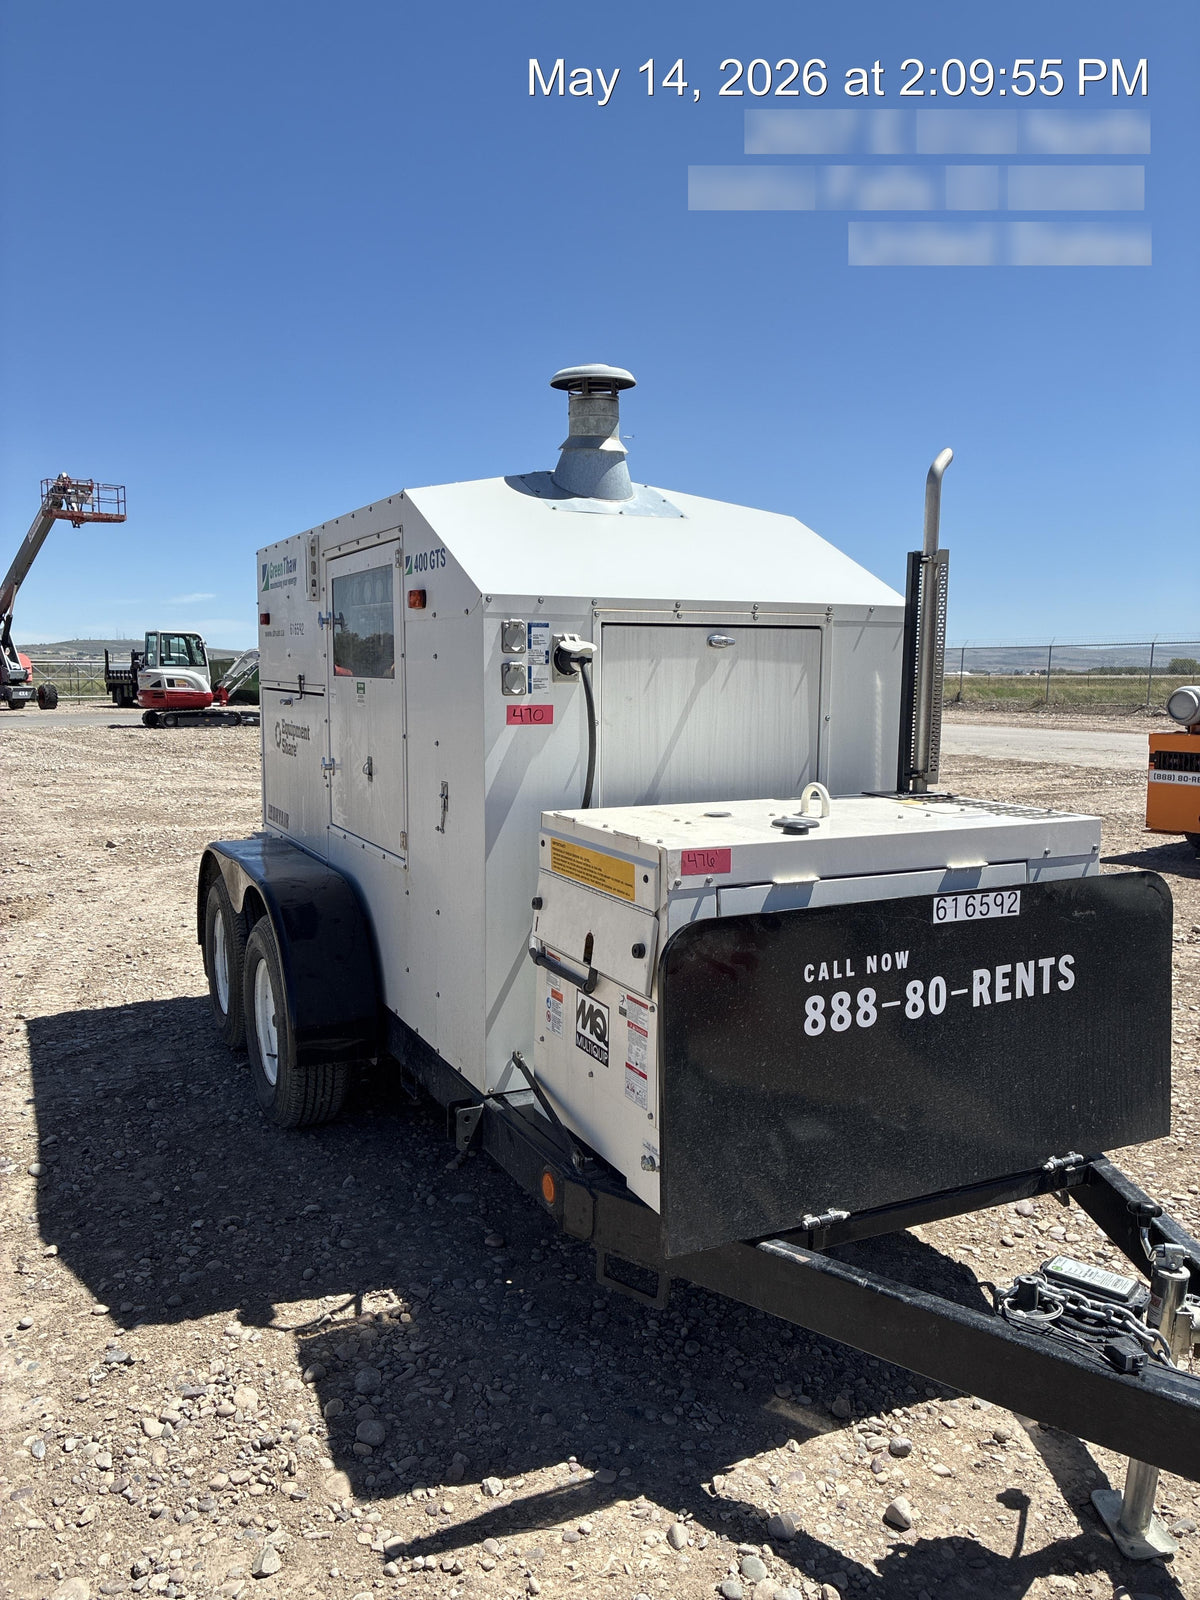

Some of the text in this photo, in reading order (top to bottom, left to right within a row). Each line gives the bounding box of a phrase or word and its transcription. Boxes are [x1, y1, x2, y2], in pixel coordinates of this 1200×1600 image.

[414, 547, 446, 573] 400 GTS
[512, 707, 544, 722] 470
[281, 718, 310, 741] Equipment
[281, 738, 297, 757] Share
[1153, 772, 1176, 782] (888)
[935, 891, 1018, 921] 616592
[803, 950, 910, 983] CALL NOW
[803, 954, 1076, 1037] 888-80-RENTS
[576, 998, 608, 1048] MQ
[576, 1032, 608, 1064] MULTIQUIP
